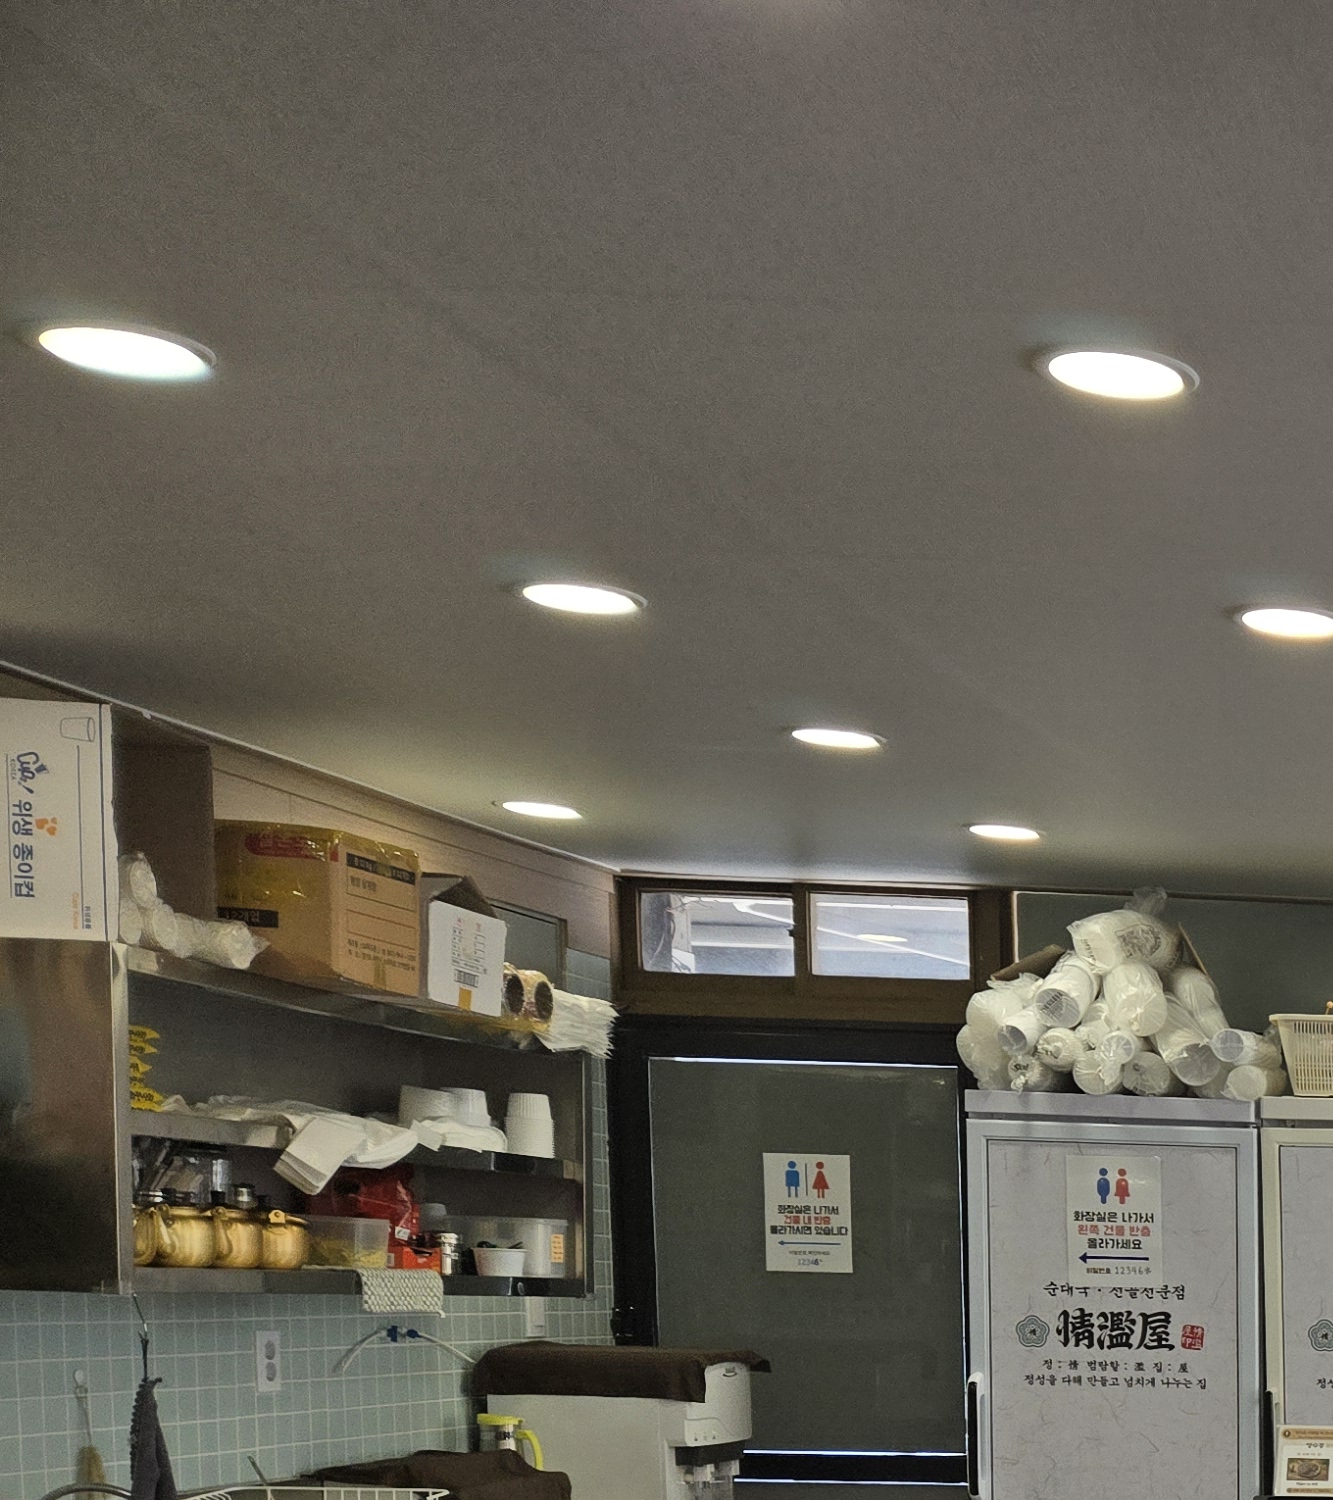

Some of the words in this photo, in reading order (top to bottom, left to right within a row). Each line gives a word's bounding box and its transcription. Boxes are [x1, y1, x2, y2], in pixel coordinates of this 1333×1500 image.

[12, 799, 36, 836] 위생
[13, 842, 36, 898] 종이컵
[777, 1204, 812, 1215] 화장실은
[813, 1205, 839, 1216] 나가서
[1073, 1210, 1118, 1223] 화장실은
[1121, 1212, 1154, 1224] 나가서
[770, 1225, 812, 1235] 올라가시면
[814, 1226, 849, 1236] 있습니다
[1077, 1225, 1100, 1236] 왼쪽
[1103, 1225, 1126, 1236] 건물
[1129, 1225, 1152, 1237] 반층
[1087, 1238, 1142, 1250] 올라가세요
[1056, 1307, 1175, 1351] 情濫屋
[1024, 1374, 1057, 1386] 정성을
[1062, 1375, 1083, 1386] 다해
[1087, 1376, 1120, 1387] 만들고
[1124, 1377, 1156, 1388] 넘치게
[1160, 1377, 1193, 1389] 나누는
[1196, 1378, 1207, 1390] 집
